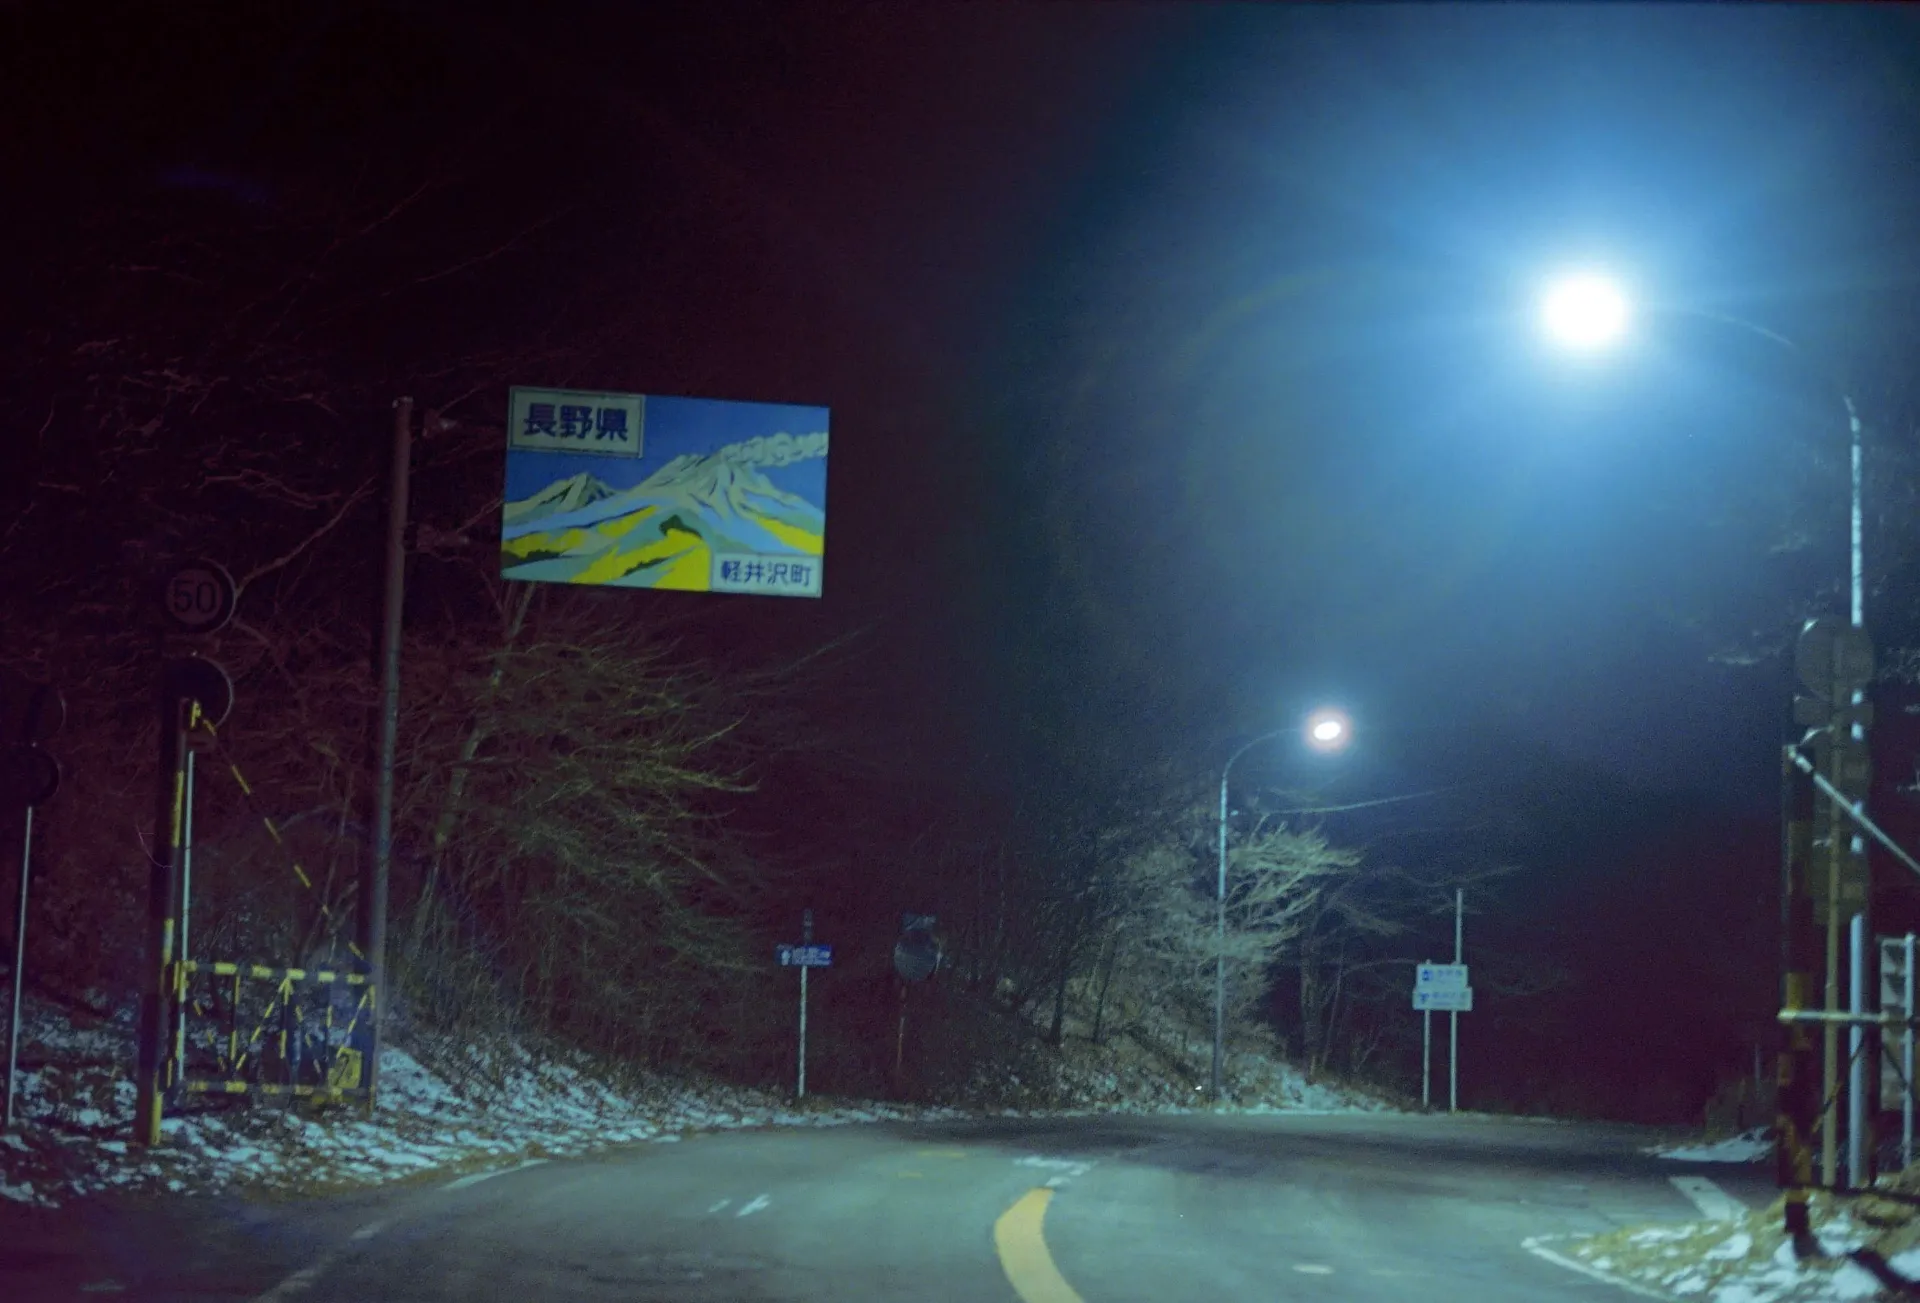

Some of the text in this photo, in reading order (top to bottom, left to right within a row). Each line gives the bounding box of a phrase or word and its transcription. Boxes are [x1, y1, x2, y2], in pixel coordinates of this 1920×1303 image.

[523, 403, 628, 441] 長野県
[721, 560, 811, 587] 軽井沢町
[174, 580, 216, 613] 50
